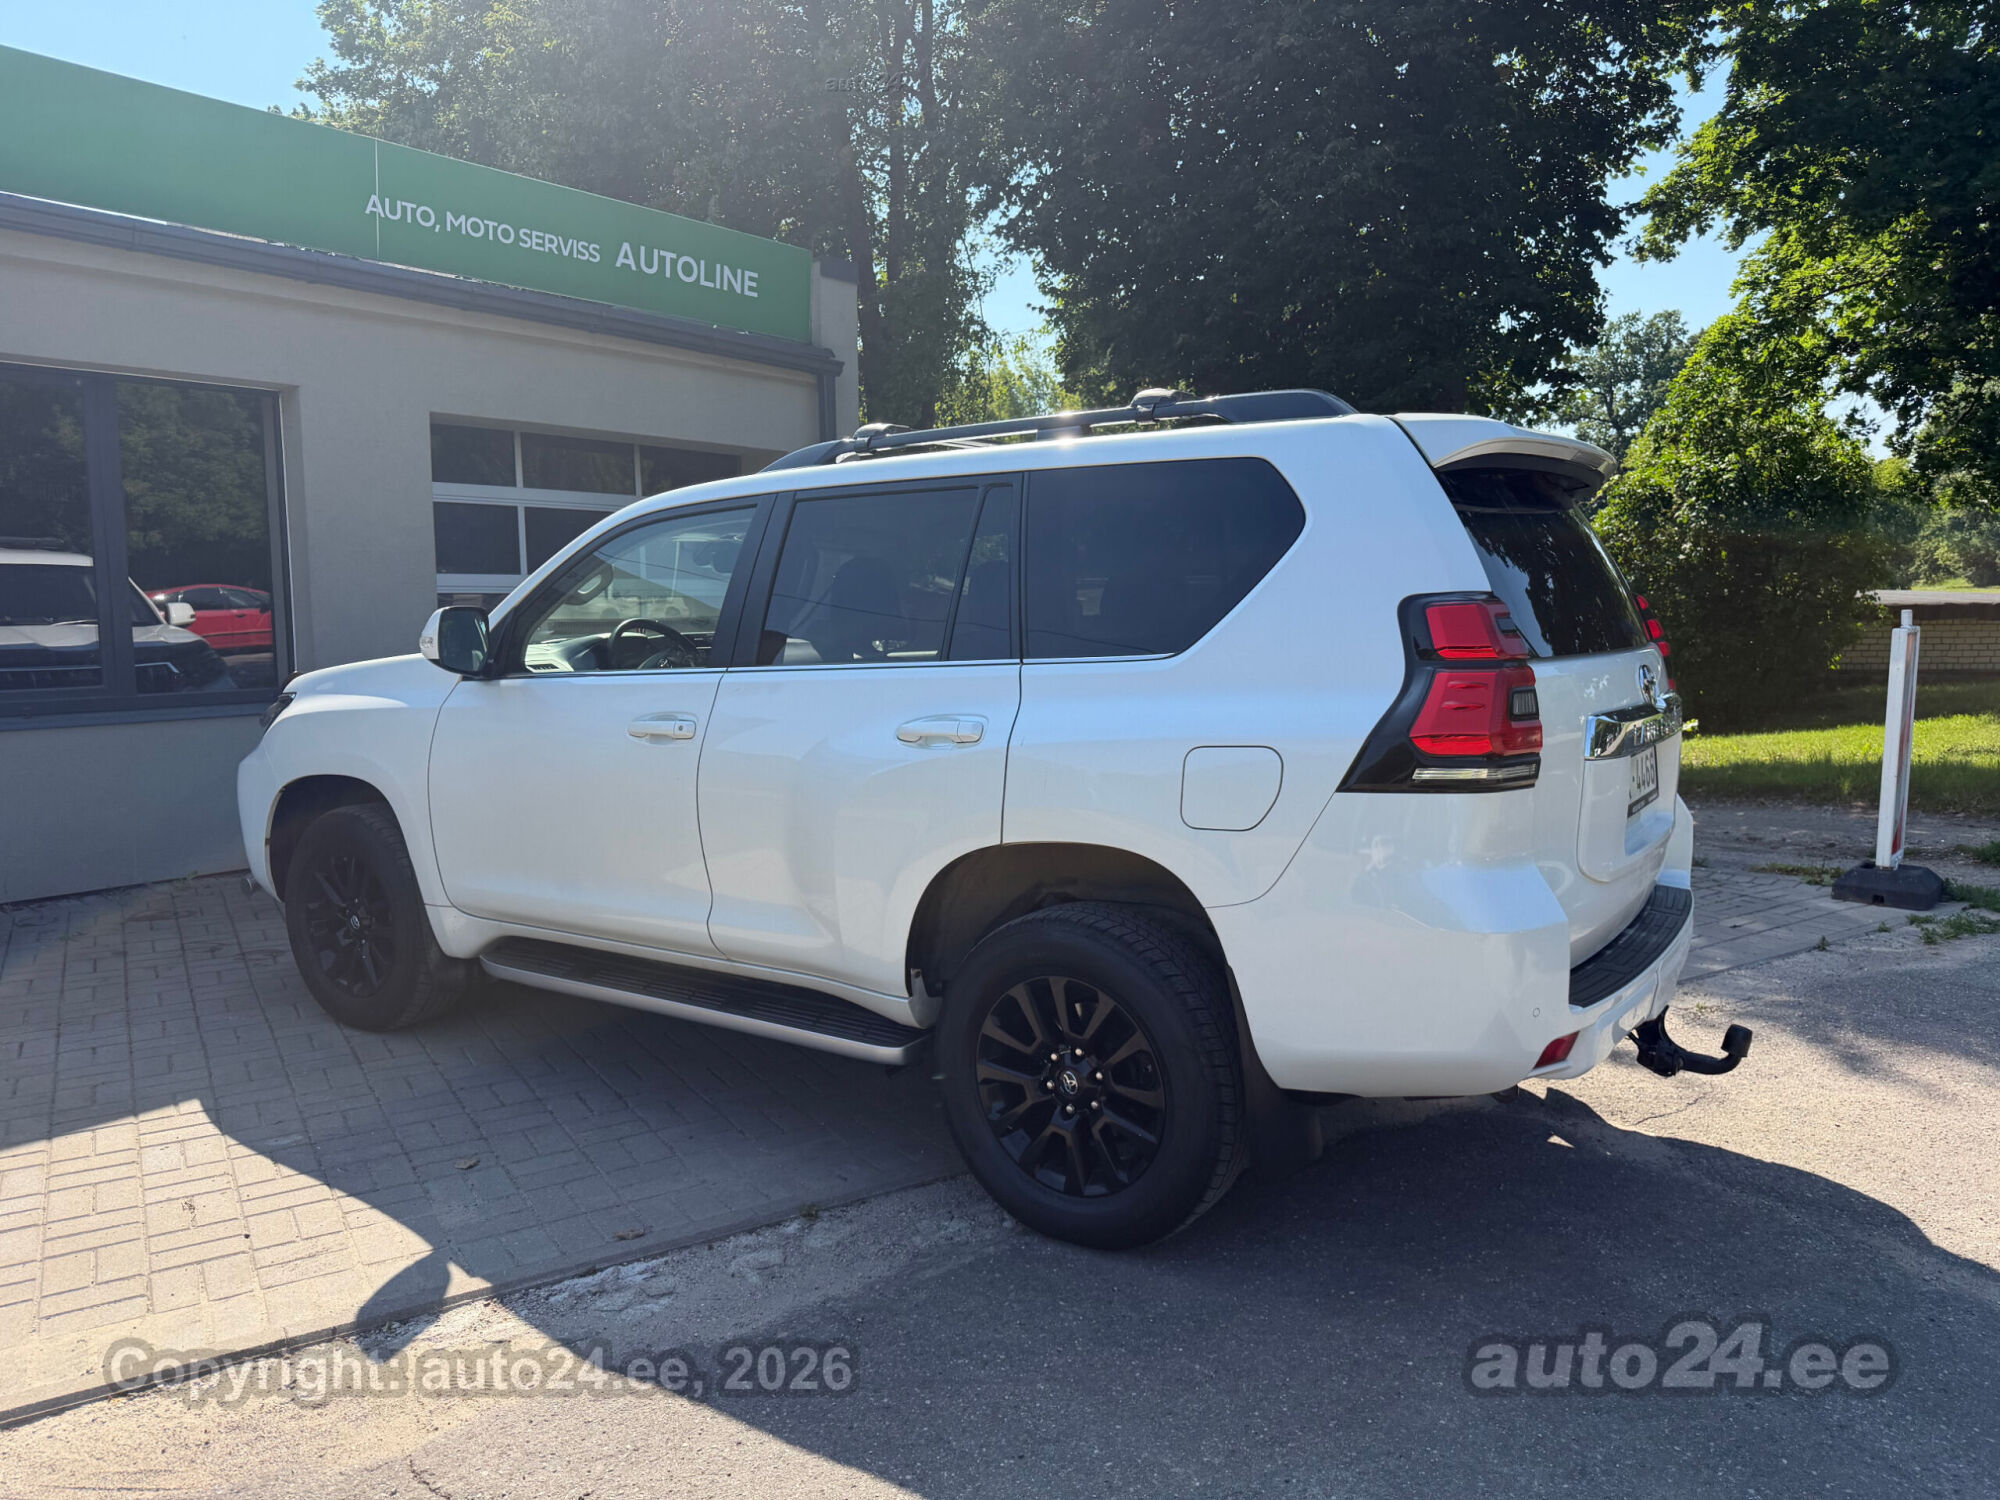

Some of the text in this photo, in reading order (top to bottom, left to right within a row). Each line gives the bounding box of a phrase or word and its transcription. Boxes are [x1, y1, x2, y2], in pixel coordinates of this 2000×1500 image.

[365, 195, 759, 298] AUTO, MOTO SERVISS AUTOLINE
